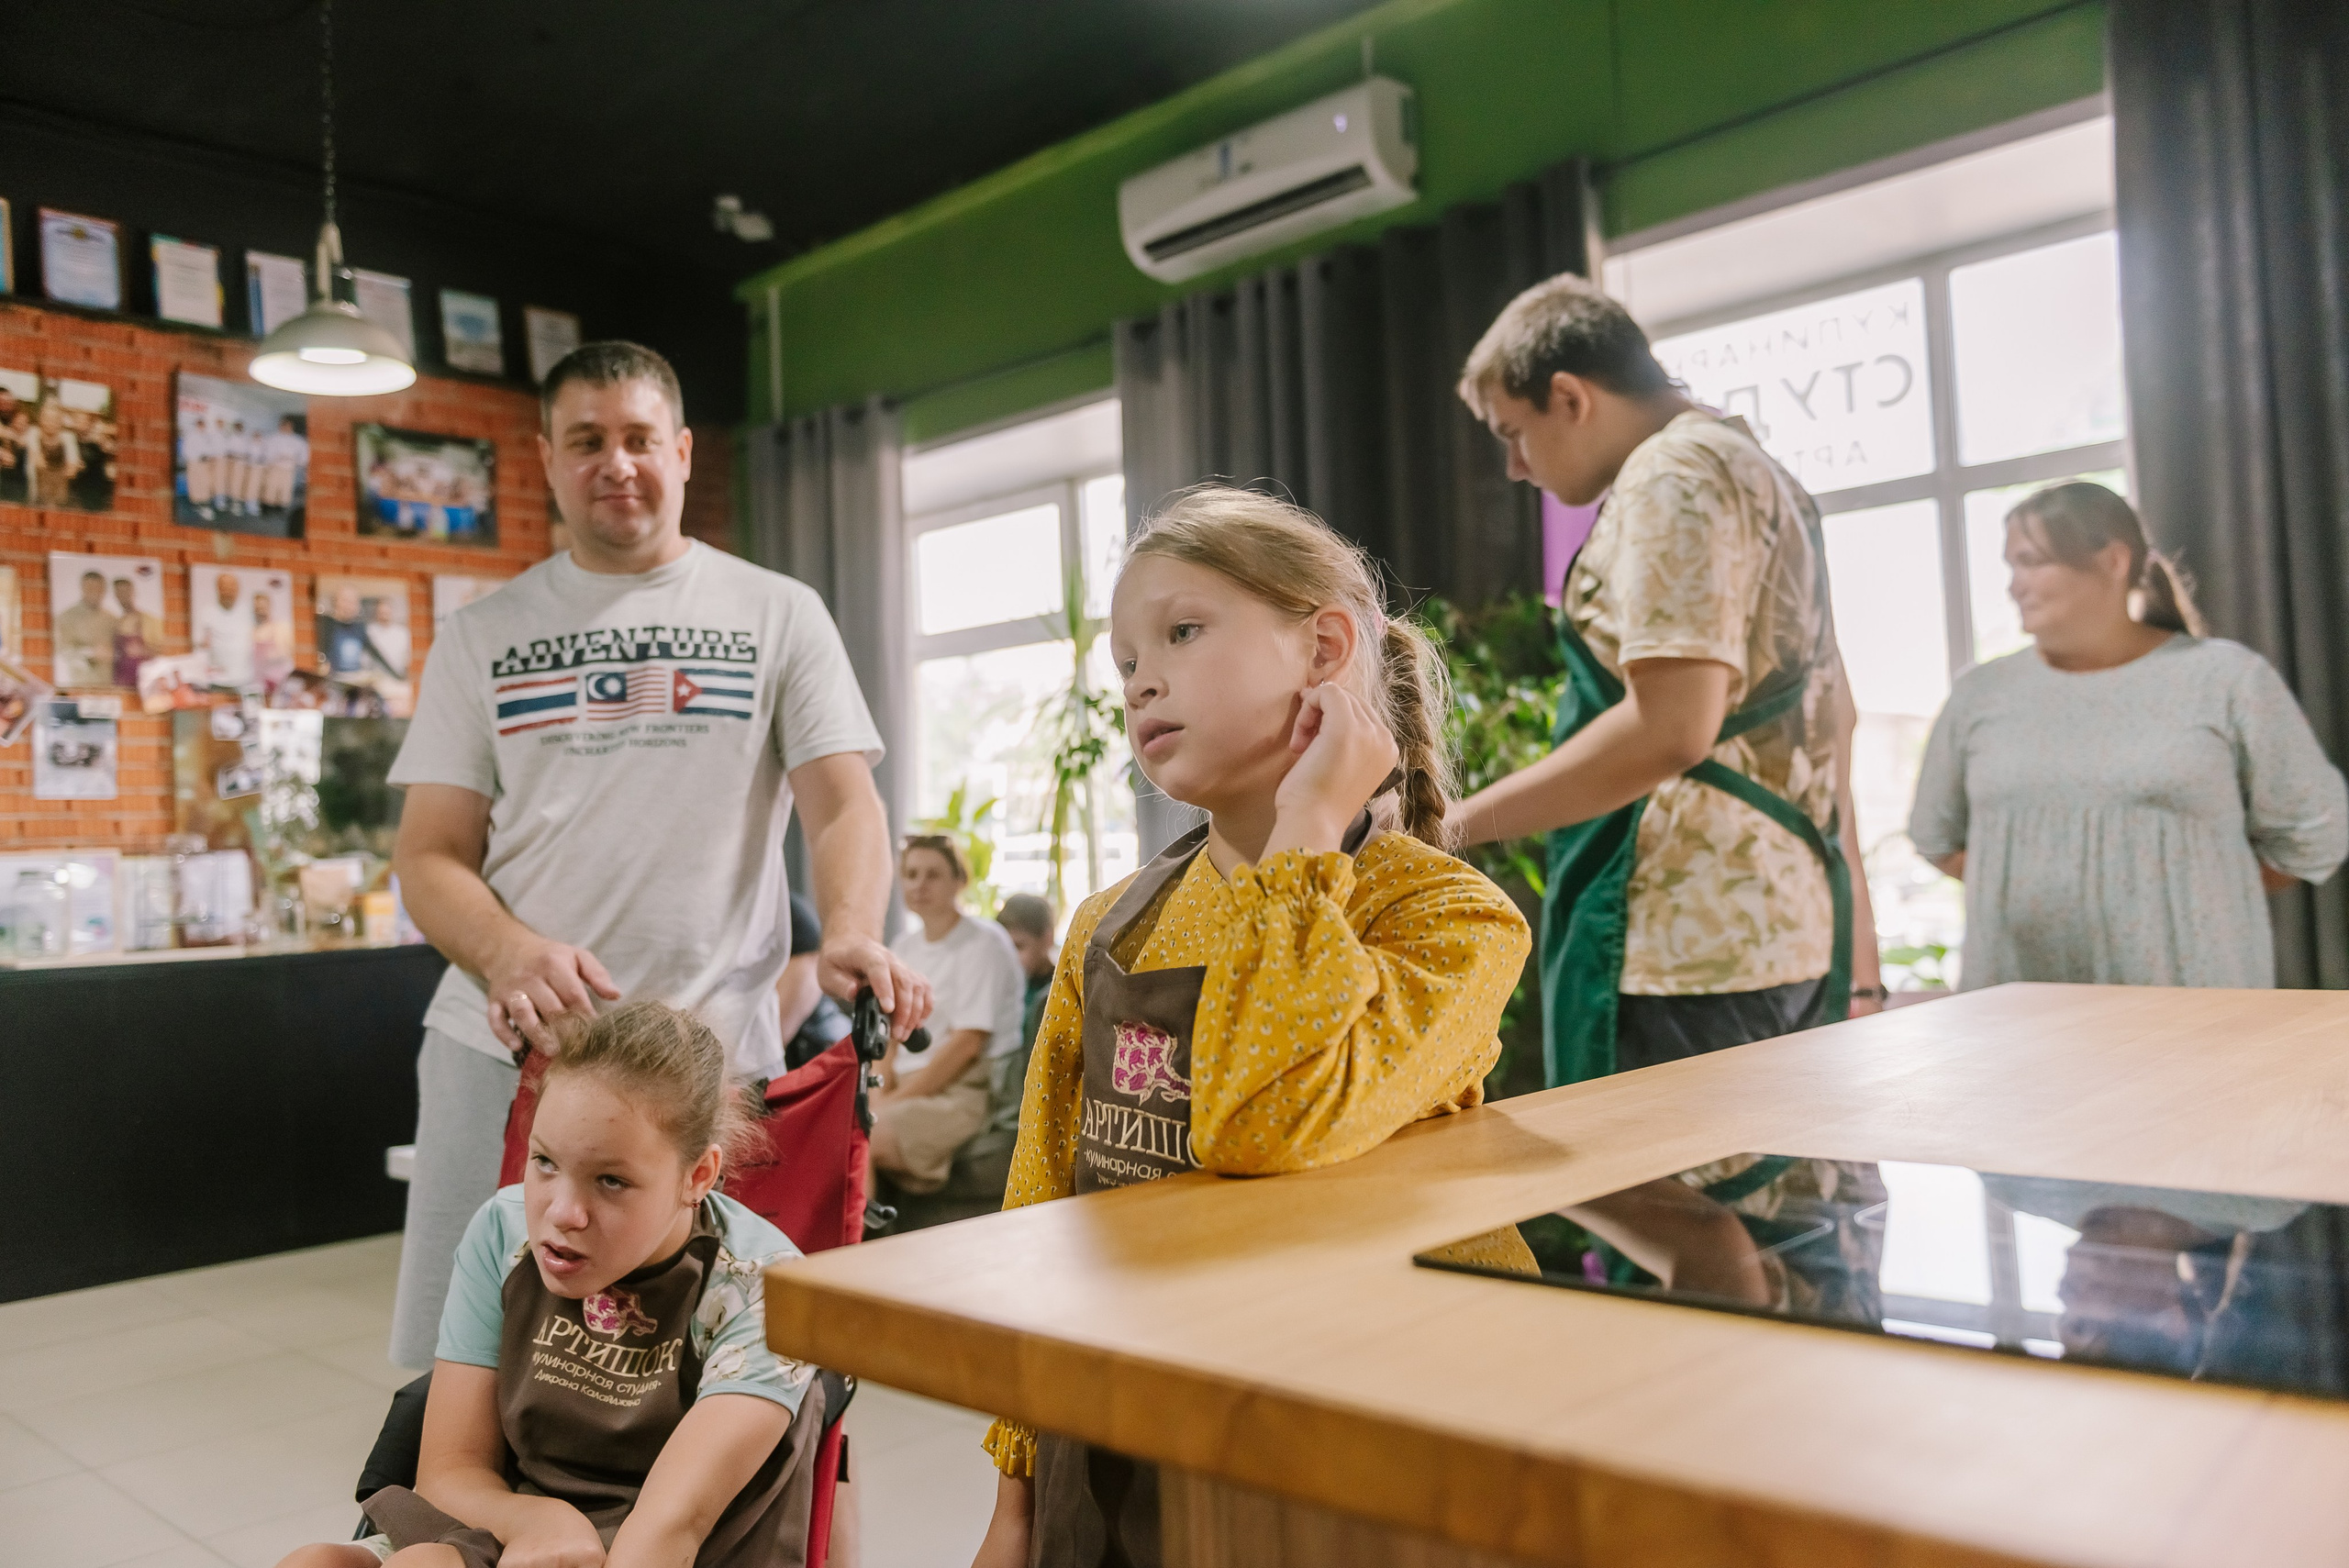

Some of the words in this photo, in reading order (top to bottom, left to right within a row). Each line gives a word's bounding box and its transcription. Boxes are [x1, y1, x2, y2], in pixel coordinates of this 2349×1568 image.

[492, 625, 758, 678] ADVENTURE
[645, 724, 709, 733] FRONTIERS
[532, 1315, 683, 1378] АРТИШОК
